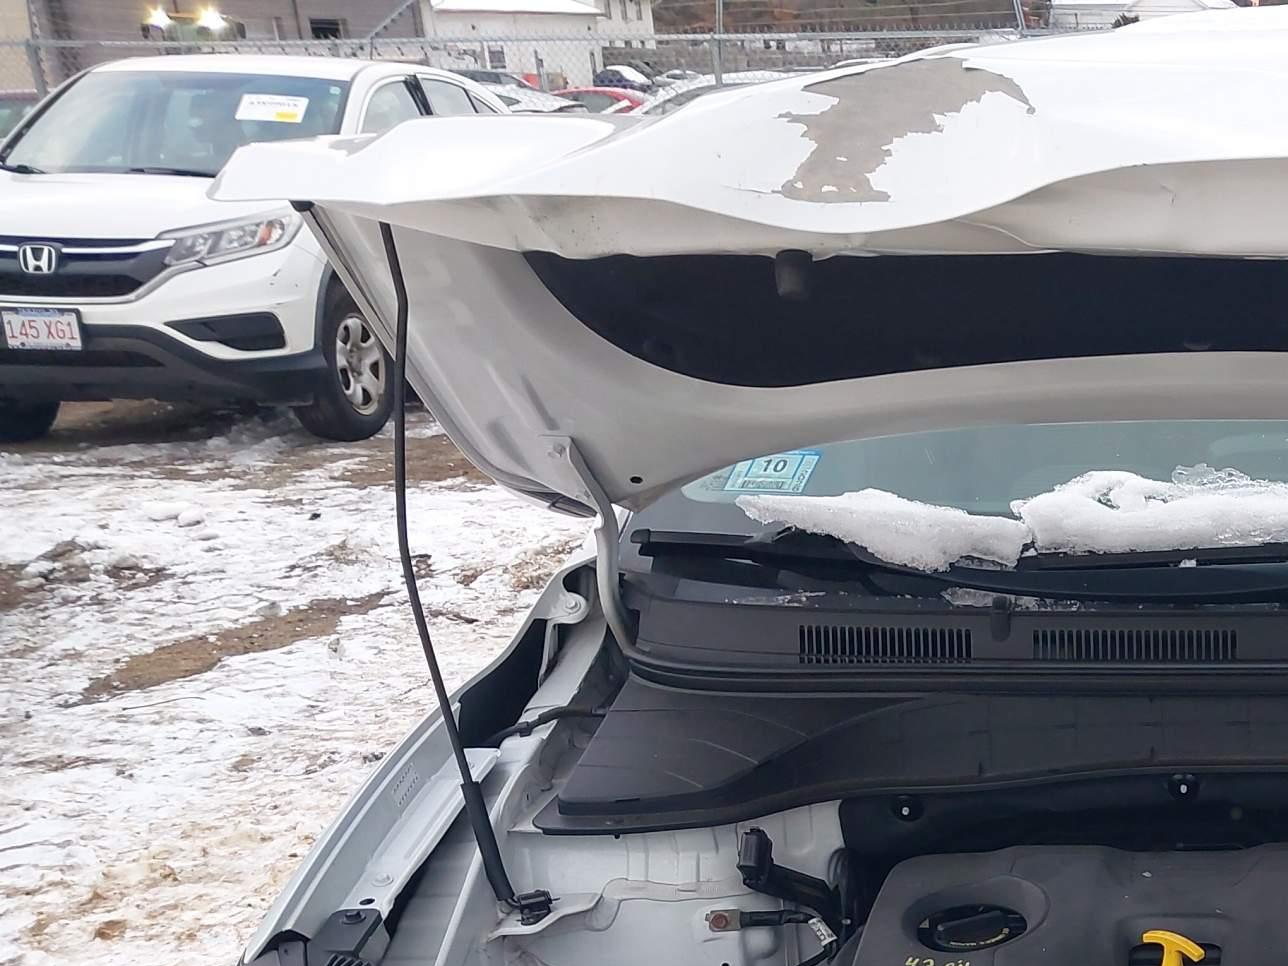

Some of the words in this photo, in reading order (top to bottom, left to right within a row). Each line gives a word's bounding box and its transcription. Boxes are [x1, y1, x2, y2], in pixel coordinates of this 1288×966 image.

[6, 319, 40, 339] 145
[44, 320, 78, 340] XG1
[763, 459, 788, 473] 10
